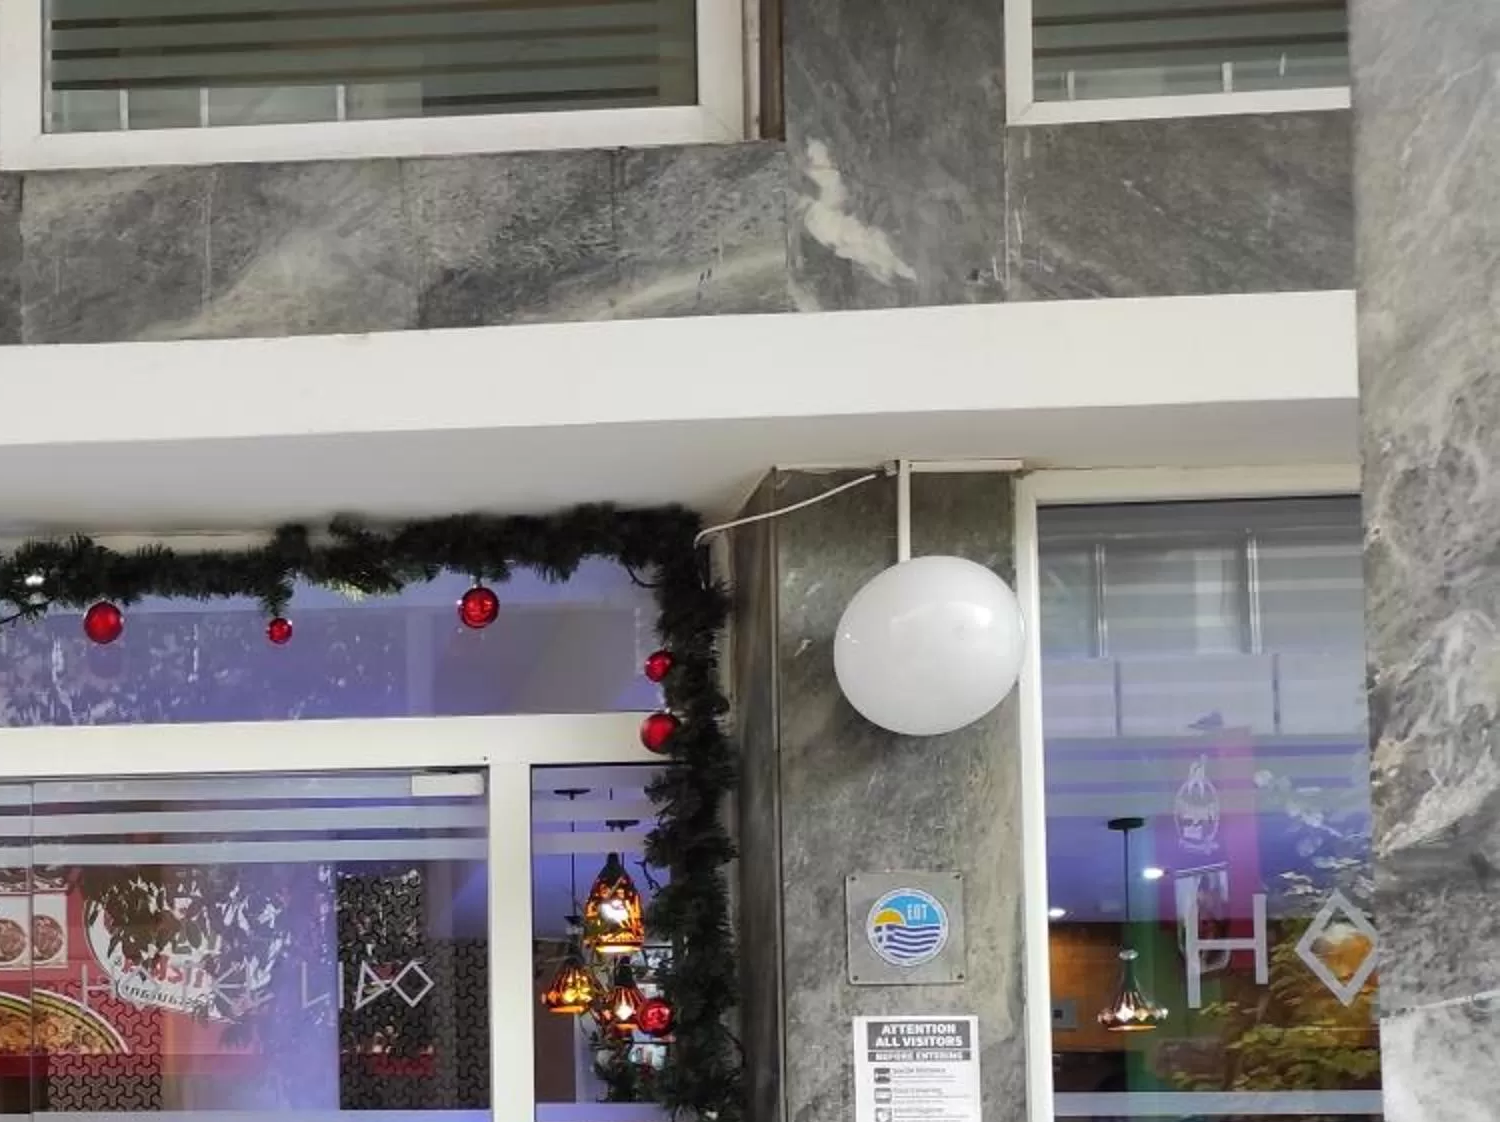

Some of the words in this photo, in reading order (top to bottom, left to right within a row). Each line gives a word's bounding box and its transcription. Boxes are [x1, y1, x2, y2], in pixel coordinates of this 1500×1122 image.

[300, 959, 434, 1012] LIDO
[881, 1023, 957, 1035] ATTENTION
[875, 1036, 900, 1047] ALL
[902, 1035, 963, 1047] VISITORS
